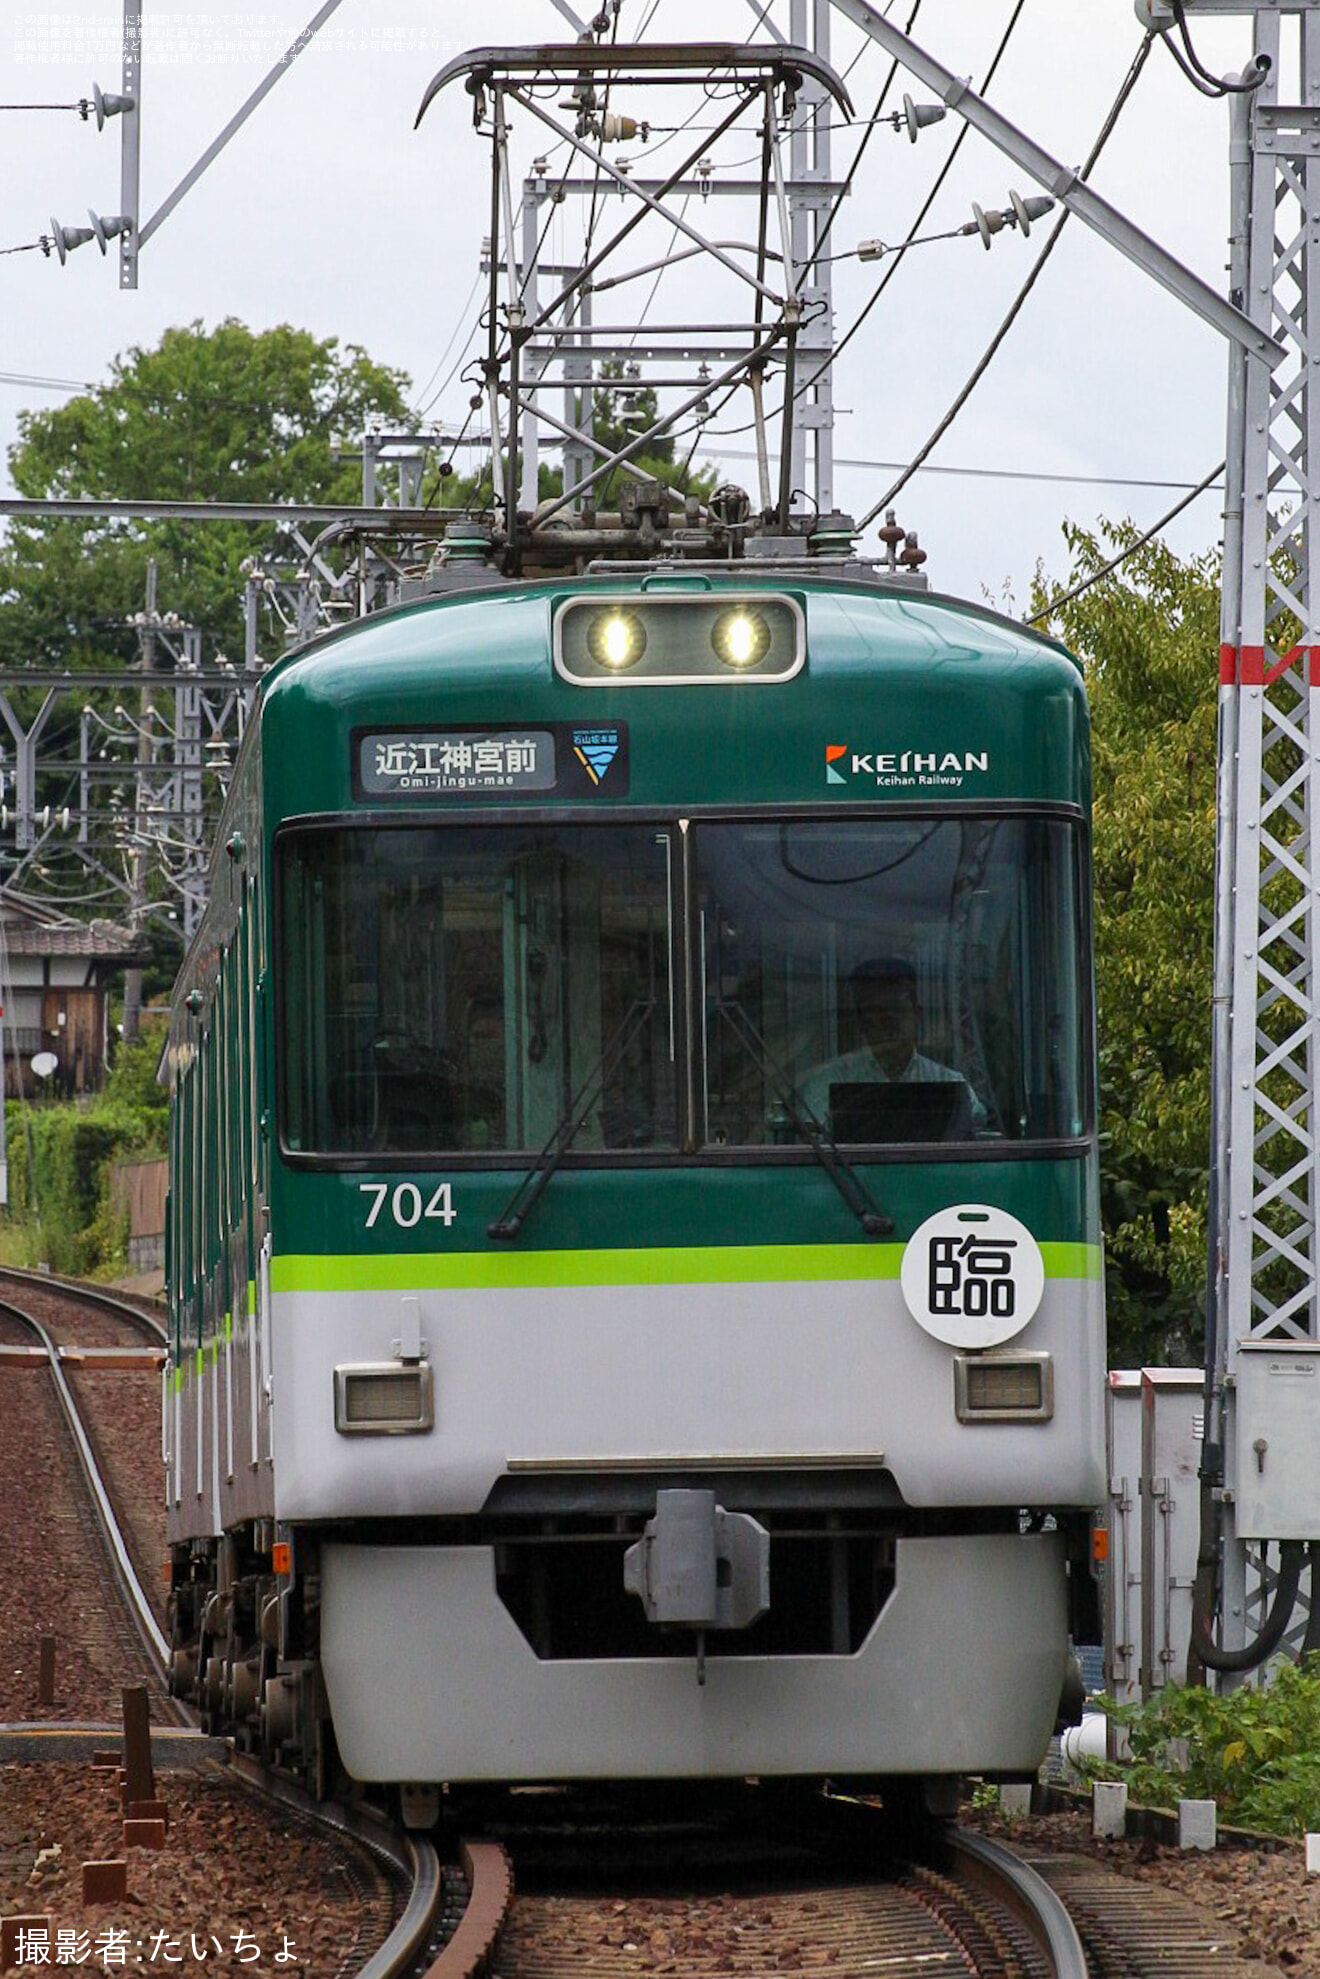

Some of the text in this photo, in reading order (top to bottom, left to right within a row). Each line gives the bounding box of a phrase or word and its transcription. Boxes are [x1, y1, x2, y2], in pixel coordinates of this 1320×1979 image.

[375, 740, 537, 775] 近江神宮前
[852, 751, 988, 773] KEIHAN
[400, 775, 514, 789] Omi-jingu-mae
[876, 775, 963, 787] Keihan Railway
[359, 1182, 458, 1228] 704
[929, 1234, 1018, 1317] 臨
